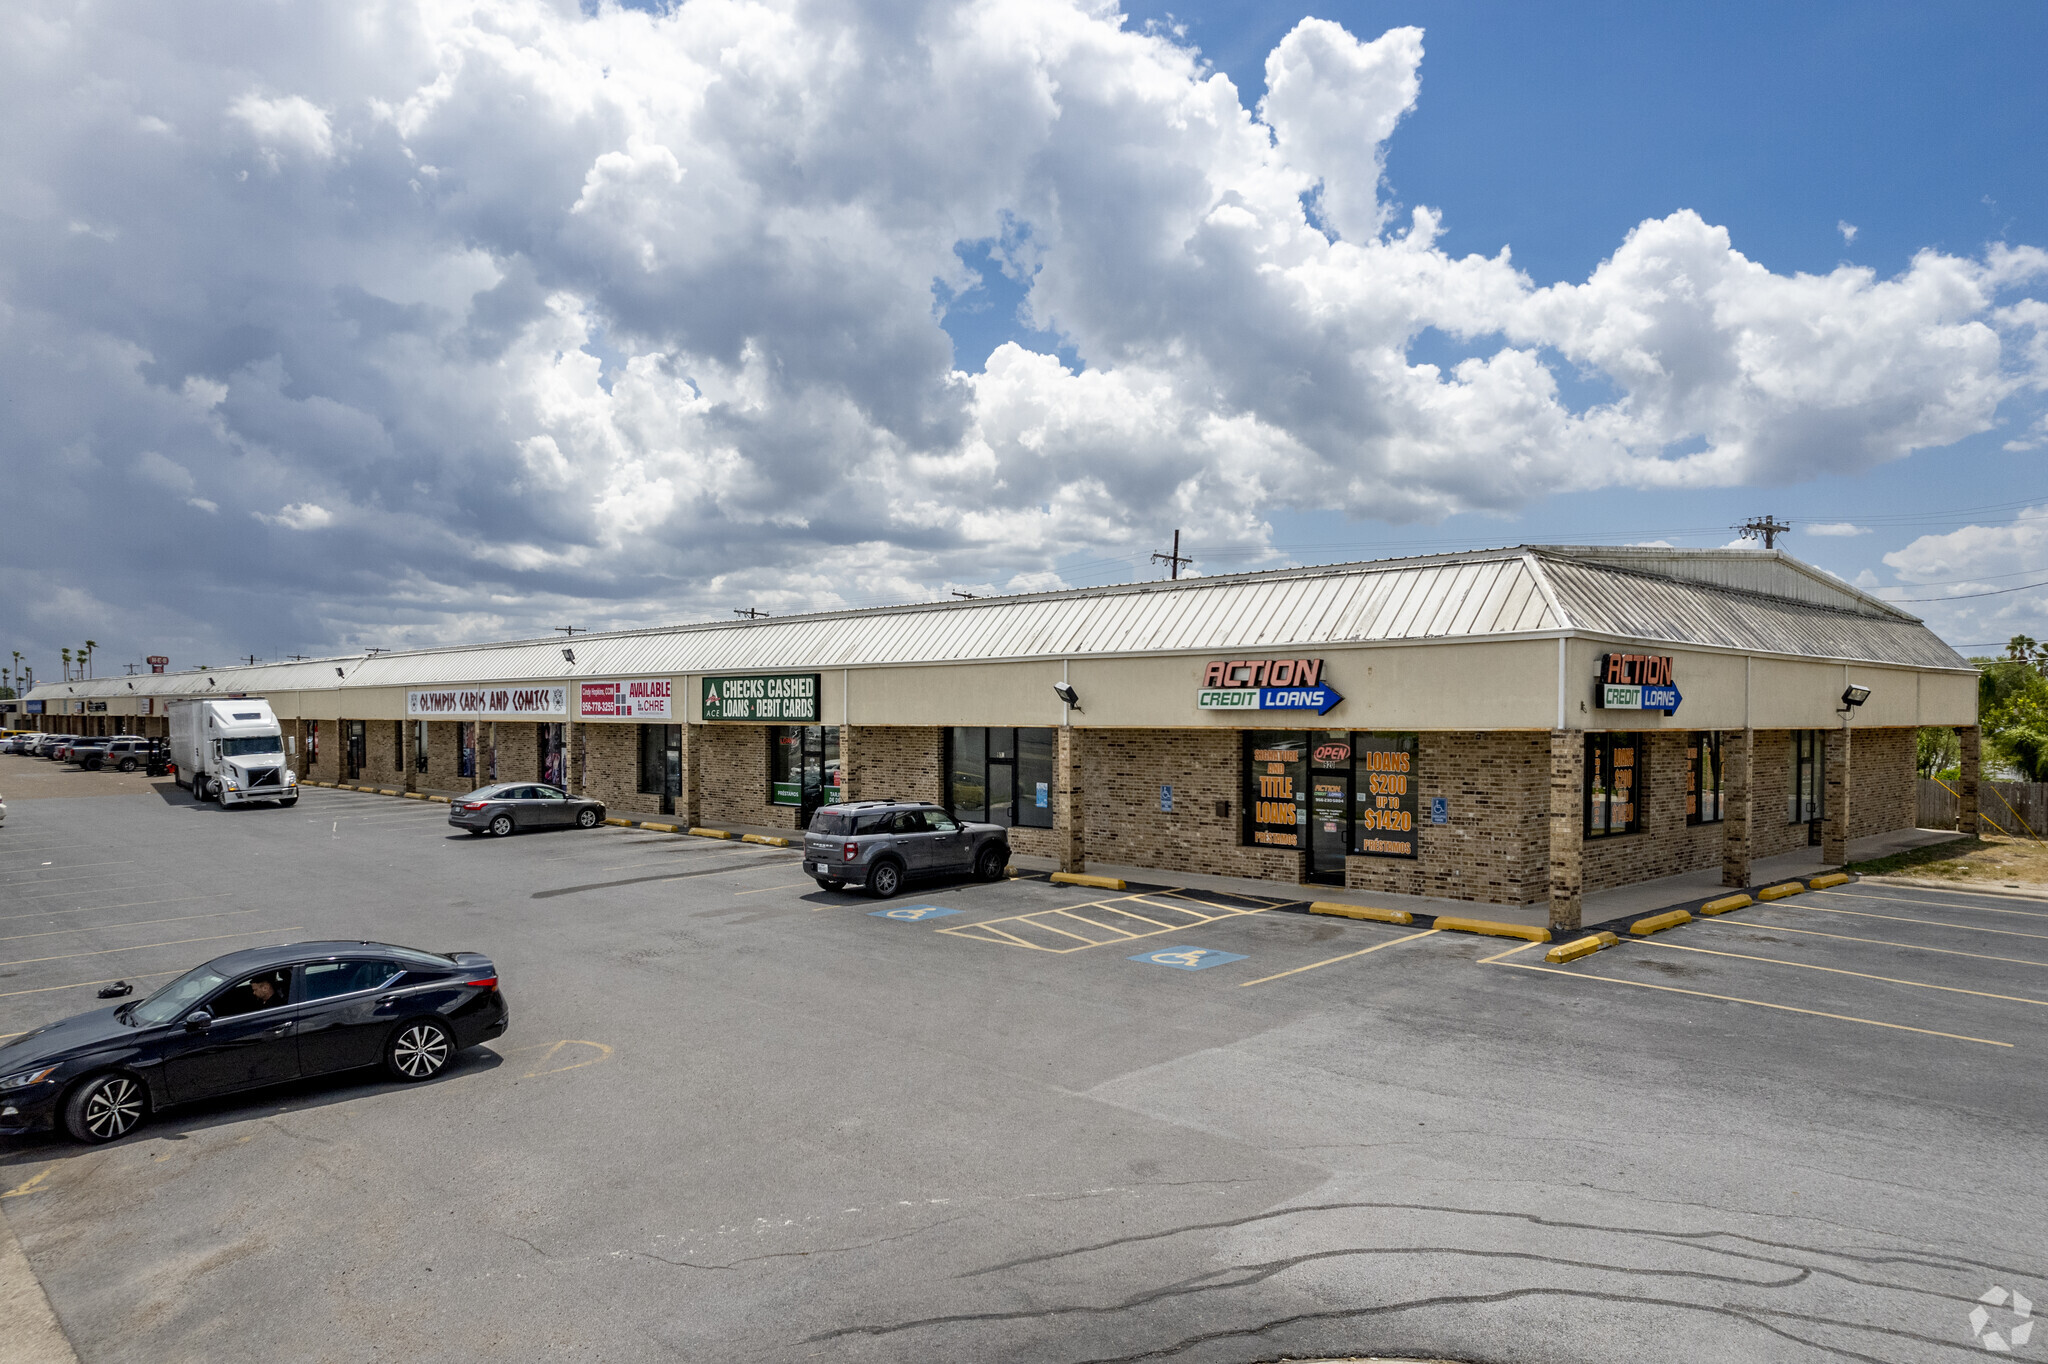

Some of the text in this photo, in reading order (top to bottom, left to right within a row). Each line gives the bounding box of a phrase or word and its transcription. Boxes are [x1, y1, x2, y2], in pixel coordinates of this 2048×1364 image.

[1203, 658, 1321, 687] ACTION
[1607, 653, 1673, 685] ACTION
[629, 682, 671, 698] AVAILABLE
[723, 678, 813, 698] CHECKS CASHED
[1606, 688, 1675, 706] CREDIT LOANS
[420, 692, 457, 711] OLYMPUS
[489, 691, 509, 711] AND
[512, 690, 549, 711] COMICS
[723, 698, 813, 718] LOANS DEBIT CARDS
[1200, 691, 1325, 706] CREDIT LOANS
[706, 709, 720, 717] ACE
[1254, 749, 1299, 762] SIGNATURE
[1316, 747, 1347, 760] OPEN
[1366, 751, 1410, 772] LOANS
[1267, 763, 1285, 774] AND
[1259, 776, 1292, 798] TITLE
[1369, 772, 1407, 795] $200
[1376, 796, 1388, 808] UP
[1389, 796, 1400, 809] TO
[1256, 801, 1296, 825] LOANS
[1364, 808, 1411, 831] $1420
[1254, 830, 1298, 846] PRÉSTAMOS
[1363, 838, 1411, 854] PRÉSTAMOS
